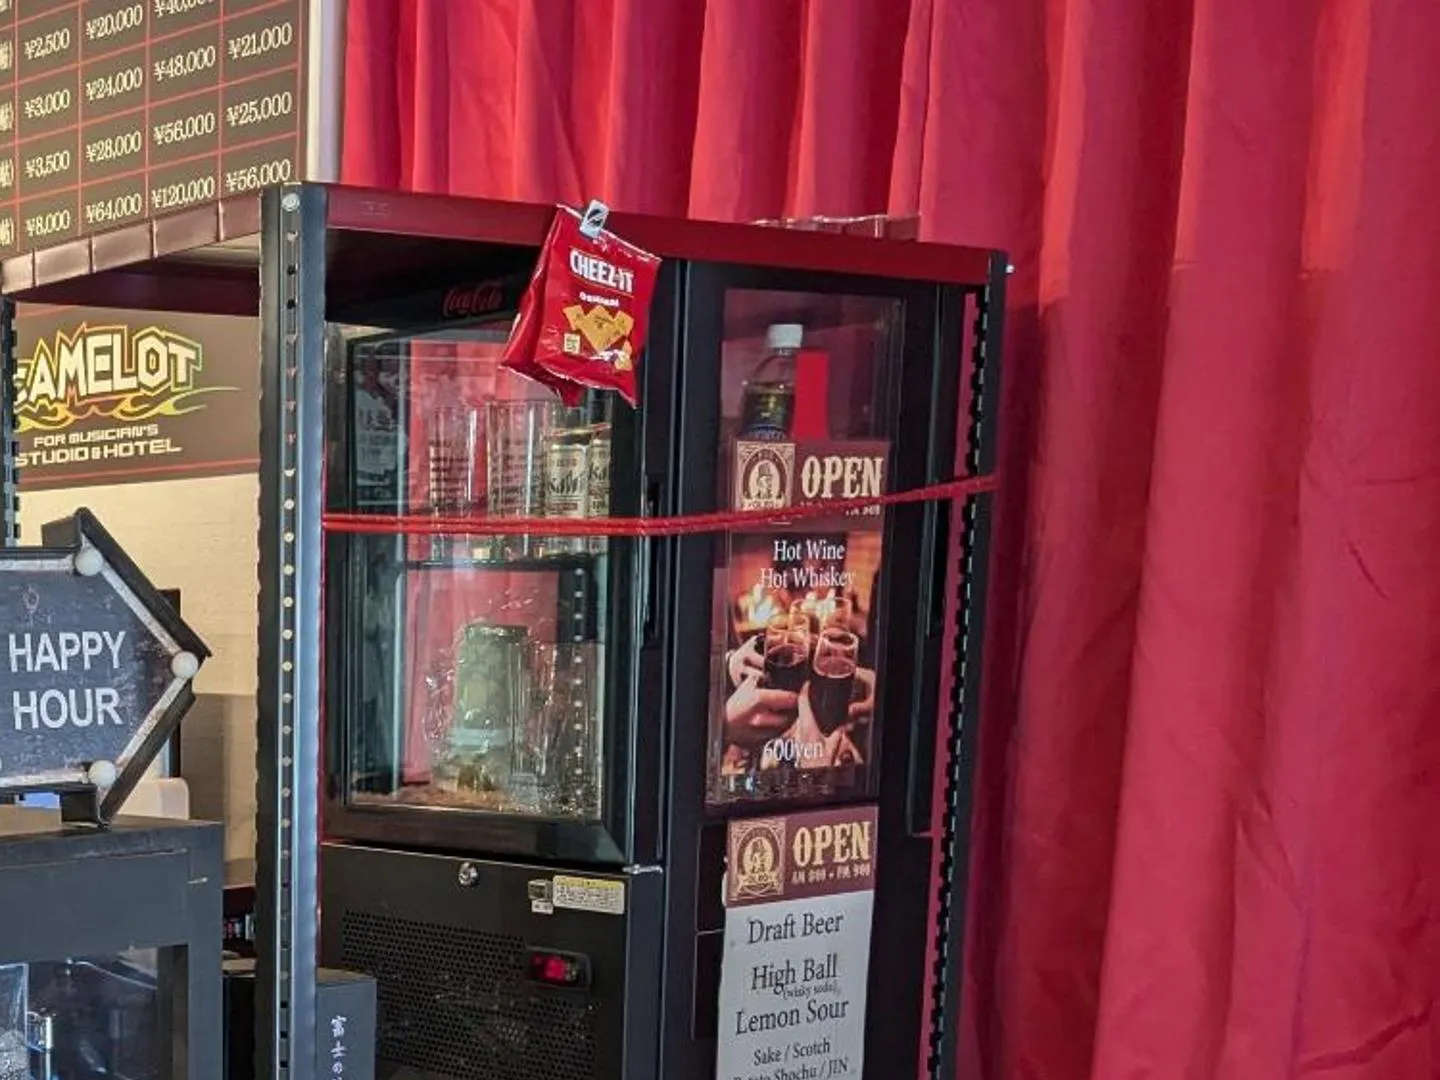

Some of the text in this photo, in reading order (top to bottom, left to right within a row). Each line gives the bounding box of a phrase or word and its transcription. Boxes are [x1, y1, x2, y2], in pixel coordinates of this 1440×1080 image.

[25, 28, 70, 61] ¥2,500
[86, 5, 143, 40] ¥20,000
[25, 89, 71, 120] ¥3,000
[86, 67, 143, 101] ¥24,000
[154, 45, 216, 82] ¥48,000
[228, 22, 292, 60] ¥21,000
[25, 150, 70, 179] ¥3,500
[86, 131, 143, 163] ¥28,000
[154, 113, 216, 145] ¥56,000
[227, 91, 292, 128] ¥25,000
[26, 210, 71, 238] ¥8,000
[86, 193, 143, 224] ¥64,000
[151, 176, 216, 209] ¥120,000
[225, 159, 292, 192] ¥56,000
[570, 249, 635, 293] CHEEZ-IT
[15, 446, 90, 468] STUDIO
[104, 438, 183, 460] HOTEL
[34, 424, 159, 449] FOR MUSICIAN'S
[801, 455, 884, 499] OPEN
[773, 540, 845, 562] Hot Wine
[761, 566, 857, 589] Hot Whiskey
[9, 631, 126, 672] HAPPY
[13, 687, 124, 730] HOUR
[763, 738, 824, 767] 600yen
[793, 821, 872, 867] OPEN
[747, 913, 844, 945] Draft Beer
[751, 953, 838, 996] High Ball
[735, 999, 849, 1036] Lemon Sour
[753, 1046, 781, 1066] Sake
[792, 1037, 830, 1059] Scotch
